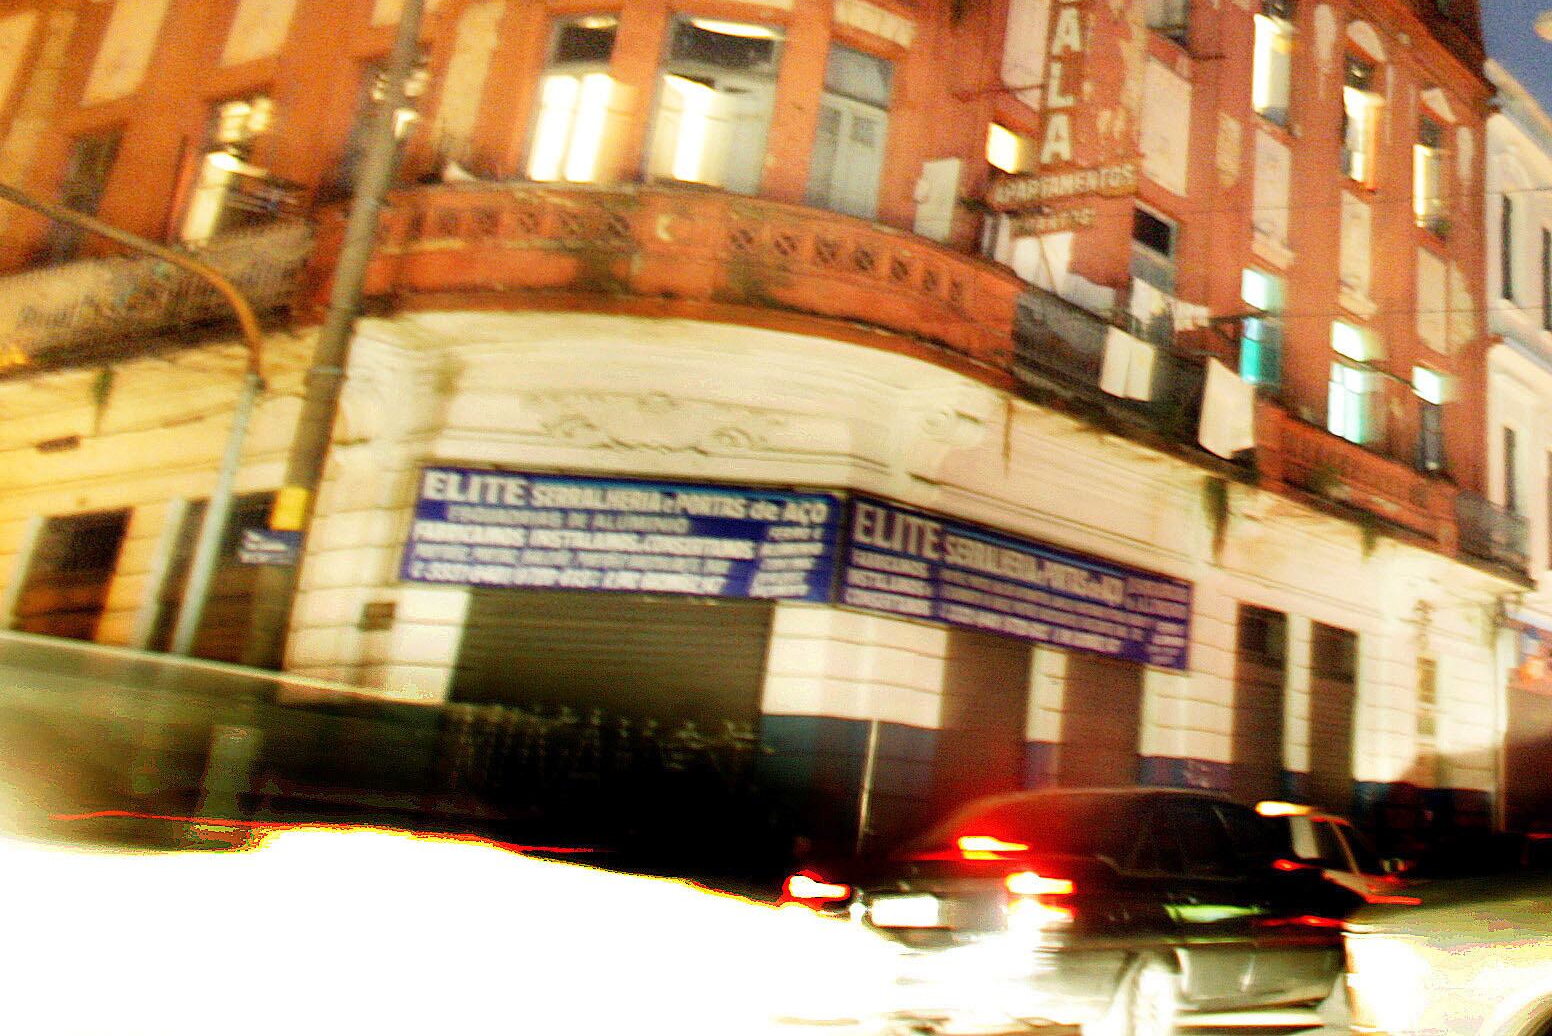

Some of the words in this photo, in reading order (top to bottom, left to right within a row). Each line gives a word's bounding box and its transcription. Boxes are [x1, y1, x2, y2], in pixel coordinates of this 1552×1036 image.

[424, 468, 529, 506] ELITE
[782, 501, 829, 525] AÇO
[854, 501, 946, 562] ELITE
